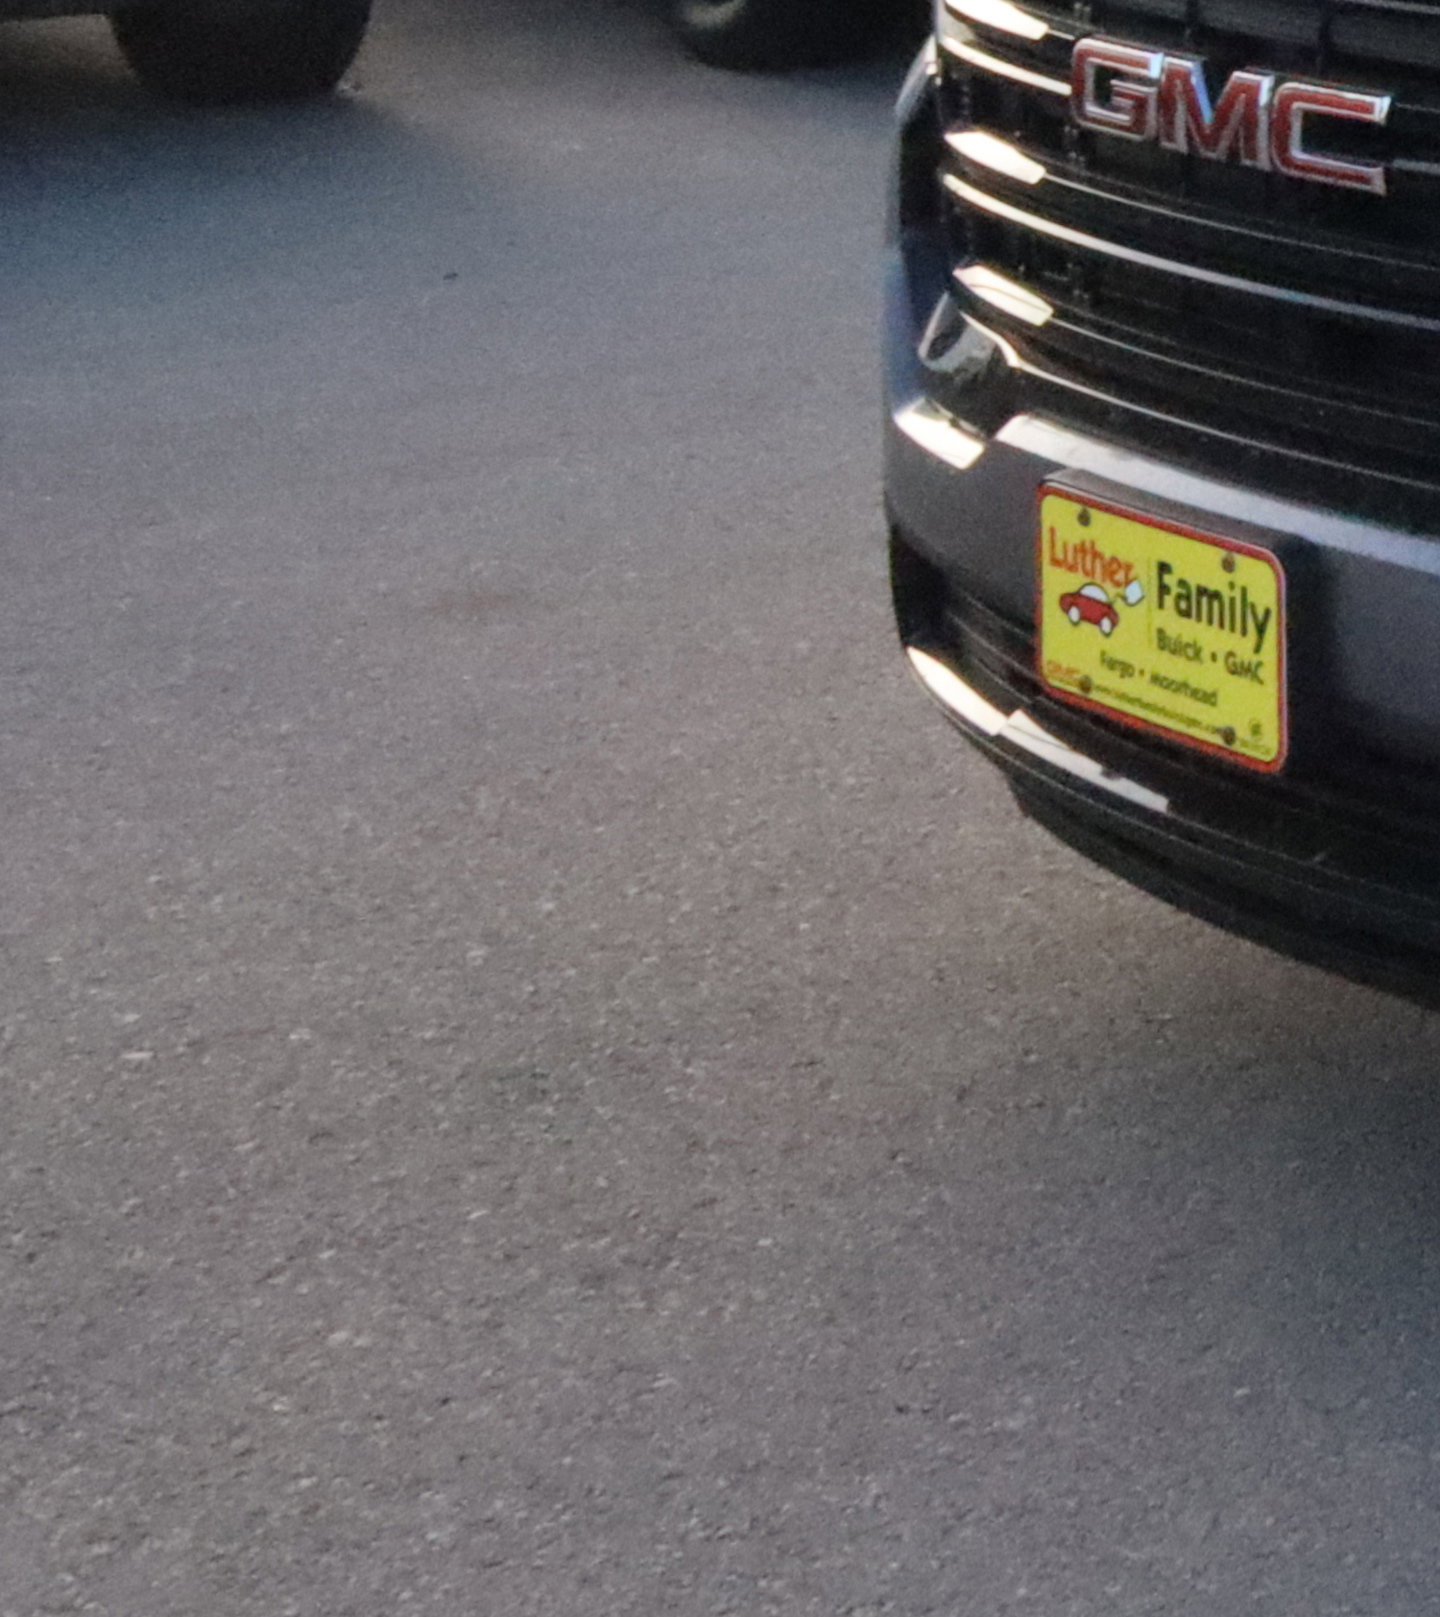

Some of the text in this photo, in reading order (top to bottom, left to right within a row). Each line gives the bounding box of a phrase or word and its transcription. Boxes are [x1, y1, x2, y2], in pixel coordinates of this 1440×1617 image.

[1071, 36, 1393, 196] GMC
[1048, 525, 1272, 655] Luther Family
[1155, 627, 1265, 686] Buick GMC
